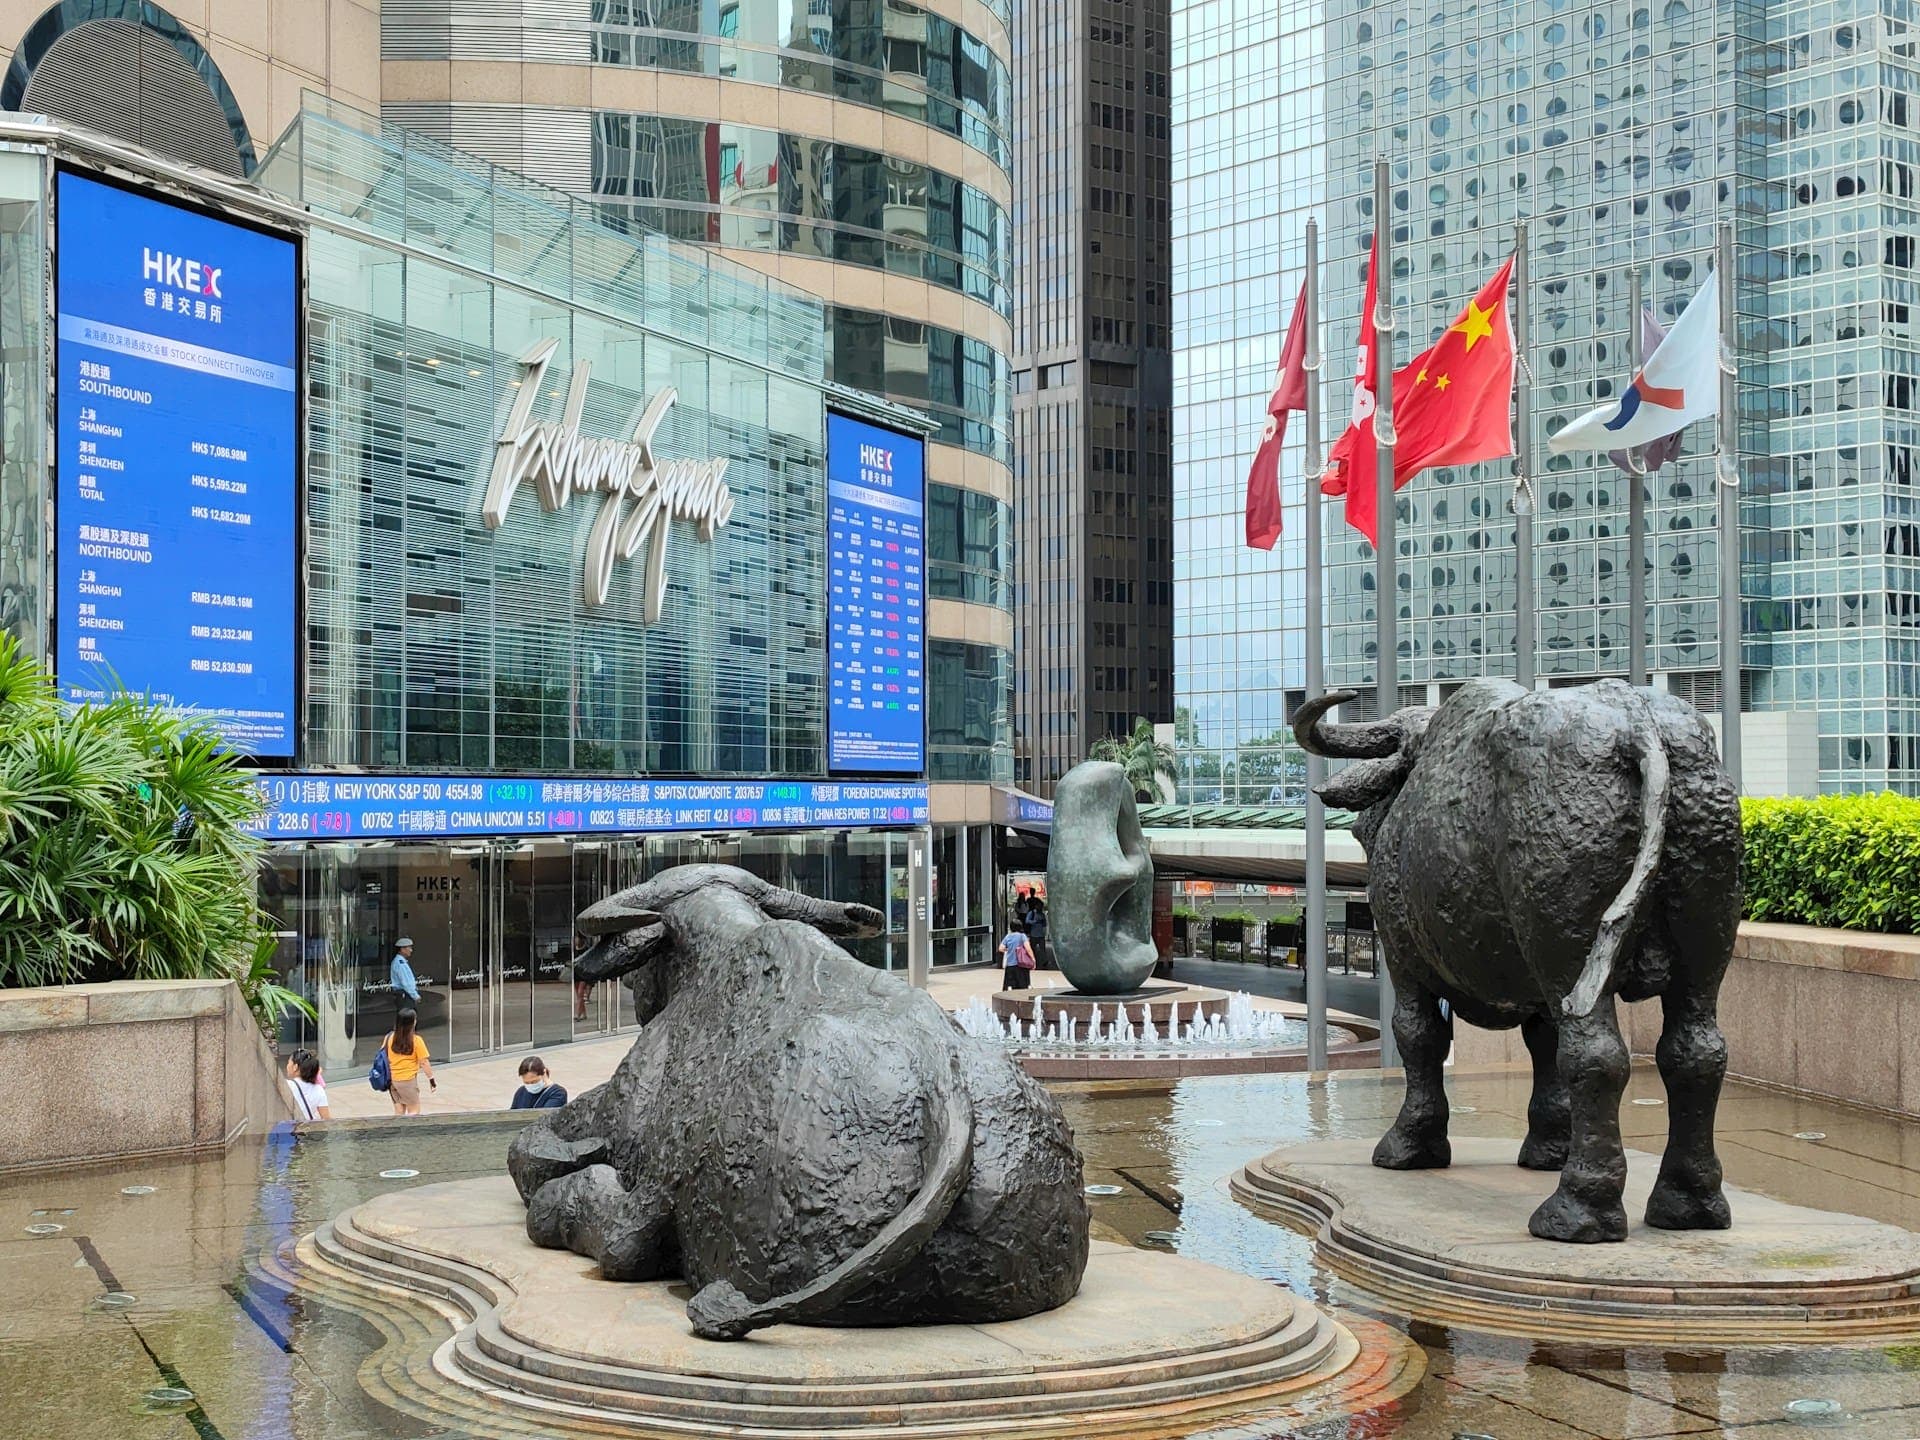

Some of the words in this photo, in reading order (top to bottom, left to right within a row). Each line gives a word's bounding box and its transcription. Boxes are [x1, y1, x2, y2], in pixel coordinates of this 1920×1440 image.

[143, 247, 222, 299] HKEX
[144, 287, 222, 324] 香港交易所
[80, 360, 111, 380] 港股通
[170, 348, 197, 364] STOCK
[197, 355, 234, 374] CONNECT
[235, 363, 275, 381] TURNOVER
[79, 379, 153, 404] SOUTHBOUND
[80, 407, 97, 421] 上海
[79, 421, 123, 438] SHANGHAI
[192, 441, 209, 455] HK$
[79, 455, 125, 471] SHENZHEN
[860, 443, 893, 472] HKEX
[192, 475, 209, 488] HK$
[79, 488, 105, 501] TOTAL
[192, 507, 209, 519] HK$
[79, 543, 152, 563] NORTHBOUND
[79, 569, 96, 582] 上海
[79, 583, 122, 597] SHANGHAI
[191, 591, 210, 604] RMB
[79, 617, 124, 630] SHENZHEN
[191, 625, 210, 638] RMB
[79, 651, 104, 662] TOTAL
[191, 659, 210, 671] RMB
[334, 784, 362, 800] NEW
[365, 783, 397, 800] YORK
[399, 783, 421, 800] S&P
[423, 783, 441, 800] 500
[445, 783, 483, 800] 4554.98
[654, 785, 688, 800] S&P/TSX
[688, 785, 732, 800] COMPOSITE
[734, 785, 764, 800] 20376.57
[843, 786, 870, 800] FOREIGN
[870, 786, 902, 800] EXCHANGE
[901, 786, 916, 800] SPOT
[361, 811, 394, 830] 00762
[398, 809, 447, 832] 中國聯通
[450, 811, 483, 827] CHINA
[484, 811, 524, 827] UNICOM
[527, 811, 545, 826] 5.51
[590, 810, 614, 825] 00823
[675, 810, 694, 824] LINK
[694, 809, 711, 823] REIT
[713, 809, 728, 823] 42.8
[814, 807, 835, 821] CHINA
[834, 807, 848, 821] RES
[848, 807, 871, 821] POWER
[277, 812, 309, 831] 328.6
[416, 876, 460, 890] HKEX
